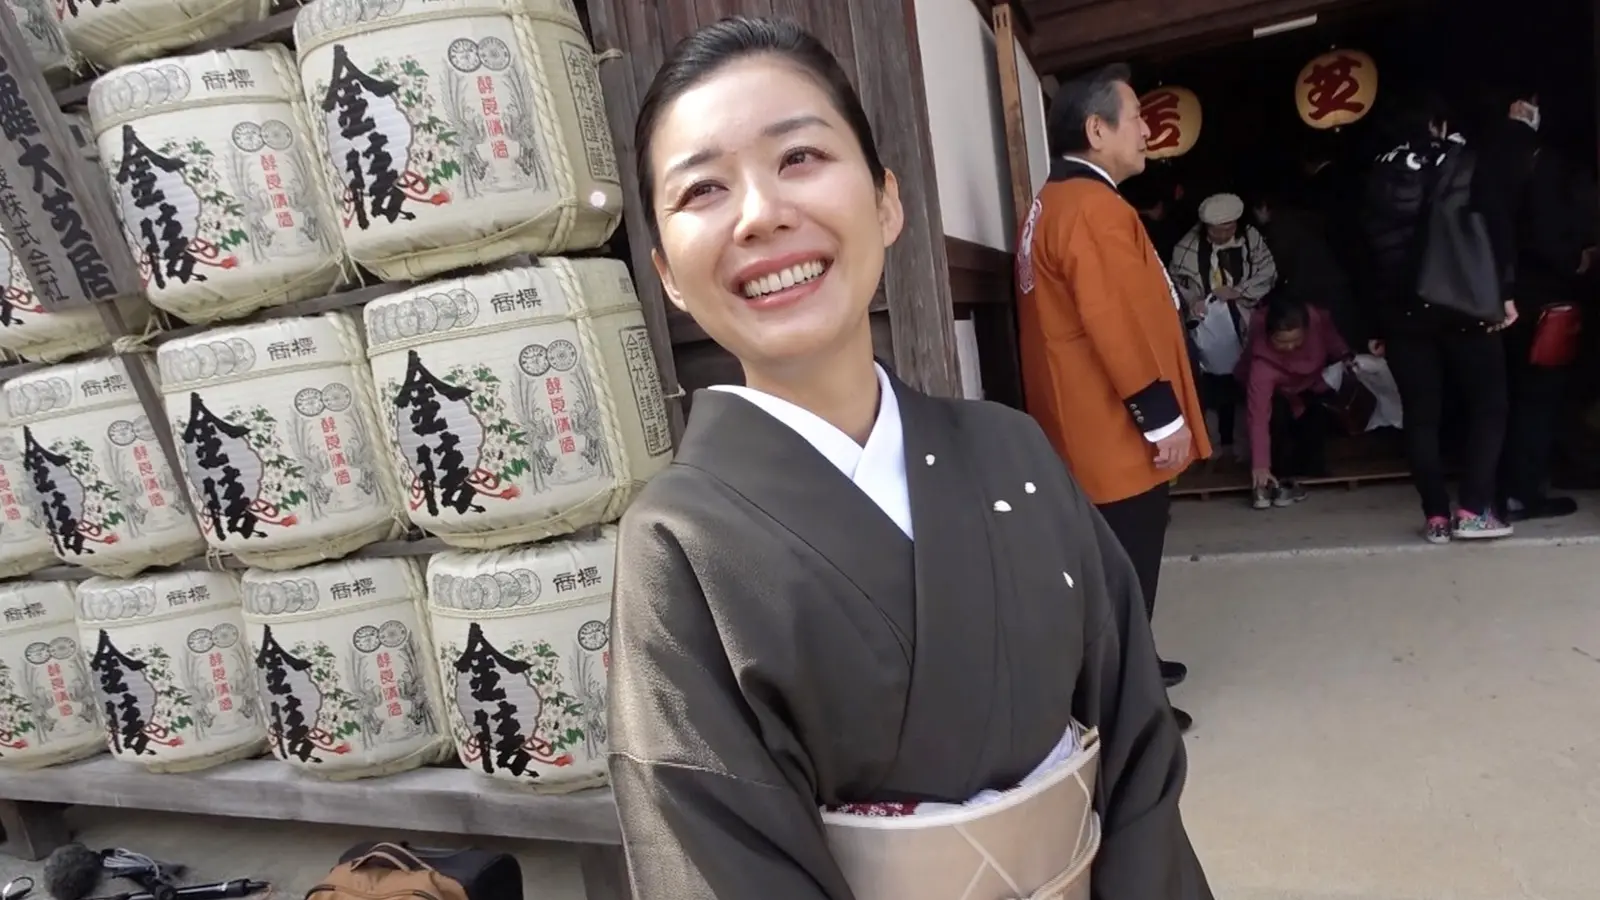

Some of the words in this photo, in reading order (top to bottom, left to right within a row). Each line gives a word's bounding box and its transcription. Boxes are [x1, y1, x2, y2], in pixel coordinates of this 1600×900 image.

[201, 67, 255, 91] 商標
[0, 55, 118, 300] 羅大芝居
[491, 287, 542, 314] 商標
[267, 336, 317, 362] 商標
[81, 374, 128, 398] 商標
[330, 577, 377, 601] 商標
[553, 565, 602, 592] 商標
[166, 585, 211, 607] 商標
[3, 602, 47, 624] 商標
